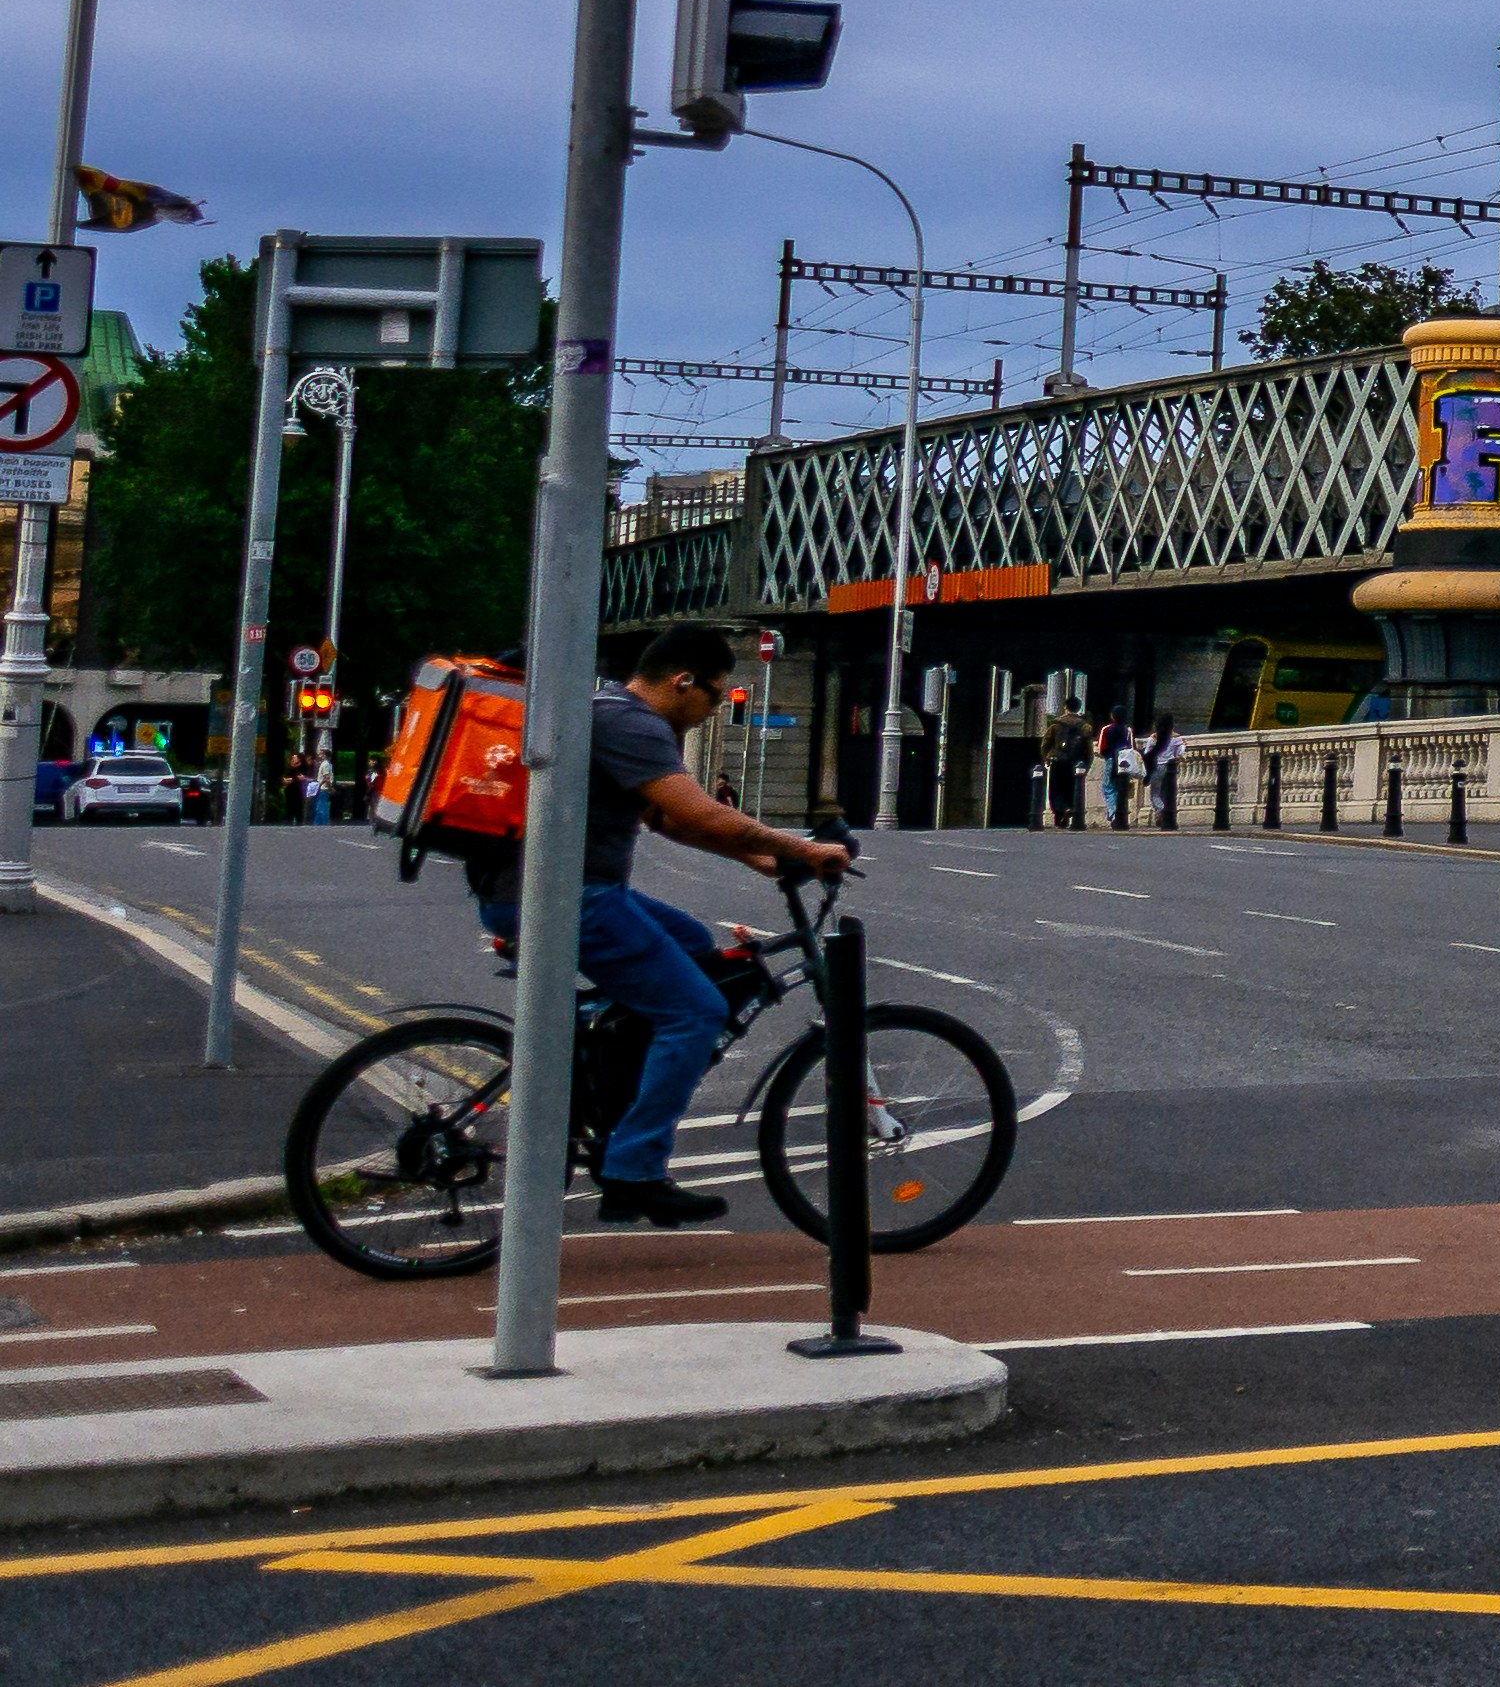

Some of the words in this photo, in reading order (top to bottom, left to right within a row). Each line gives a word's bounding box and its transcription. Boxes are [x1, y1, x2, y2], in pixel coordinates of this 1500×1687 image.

[34, 286, 55, 309] P
[16, 340, 36, 349] CAR
[39, 341, 63, 350] PARK
[15, 479, 52, 489] BUSES
[300, 653, 316, 666] 50
